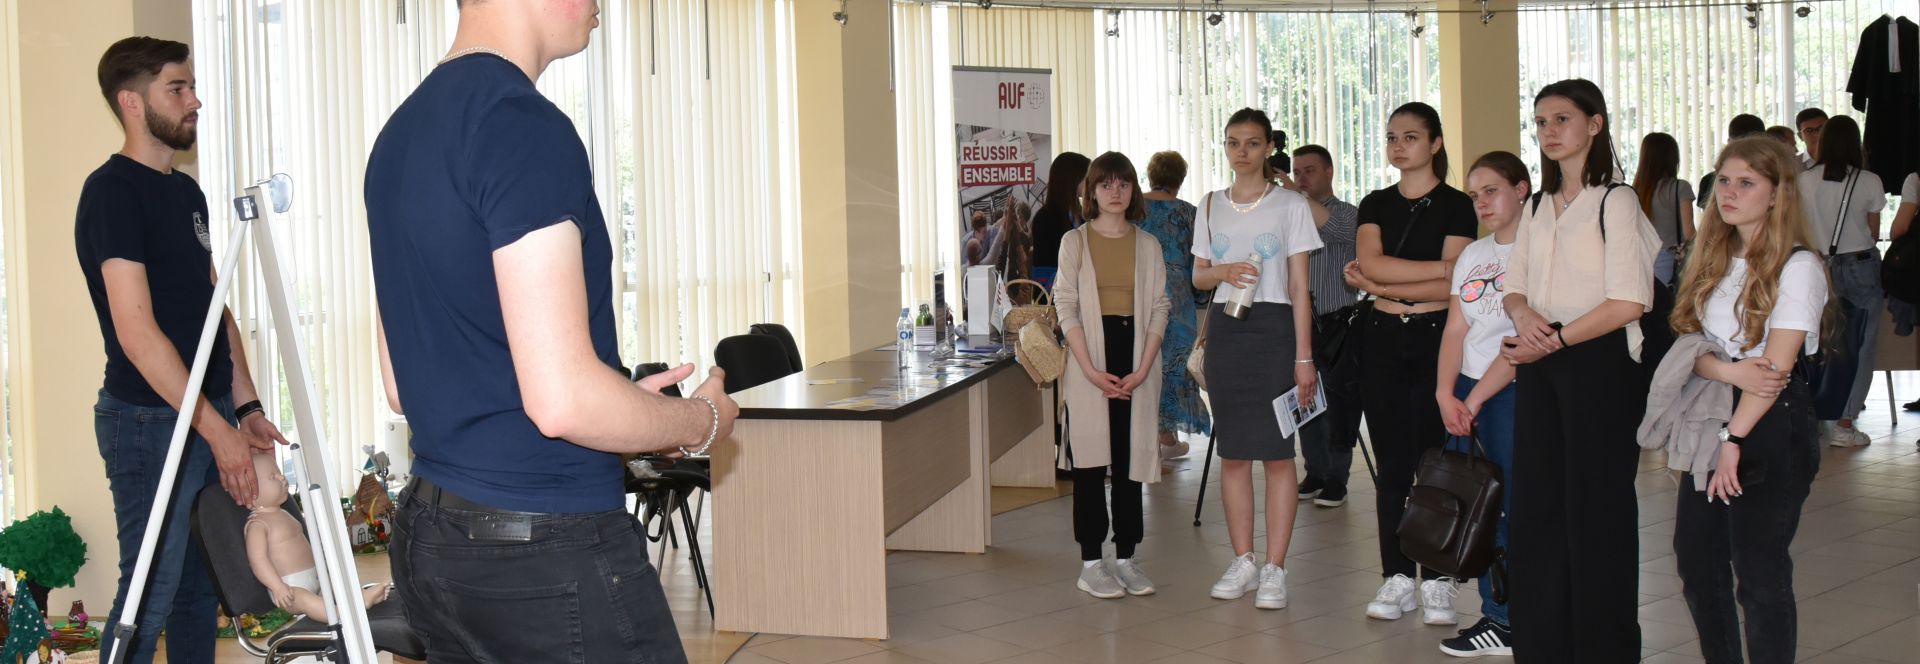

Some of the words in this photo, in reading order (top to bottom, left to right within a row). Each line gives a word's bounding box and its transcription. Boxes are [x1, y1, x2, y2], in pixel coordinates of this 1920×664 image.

[998, 82, 1025, 109] AUF
[964, 140, 1018, 161] RÉUSSIR
[964, 167, 1033, 184] ENSEMBLE
